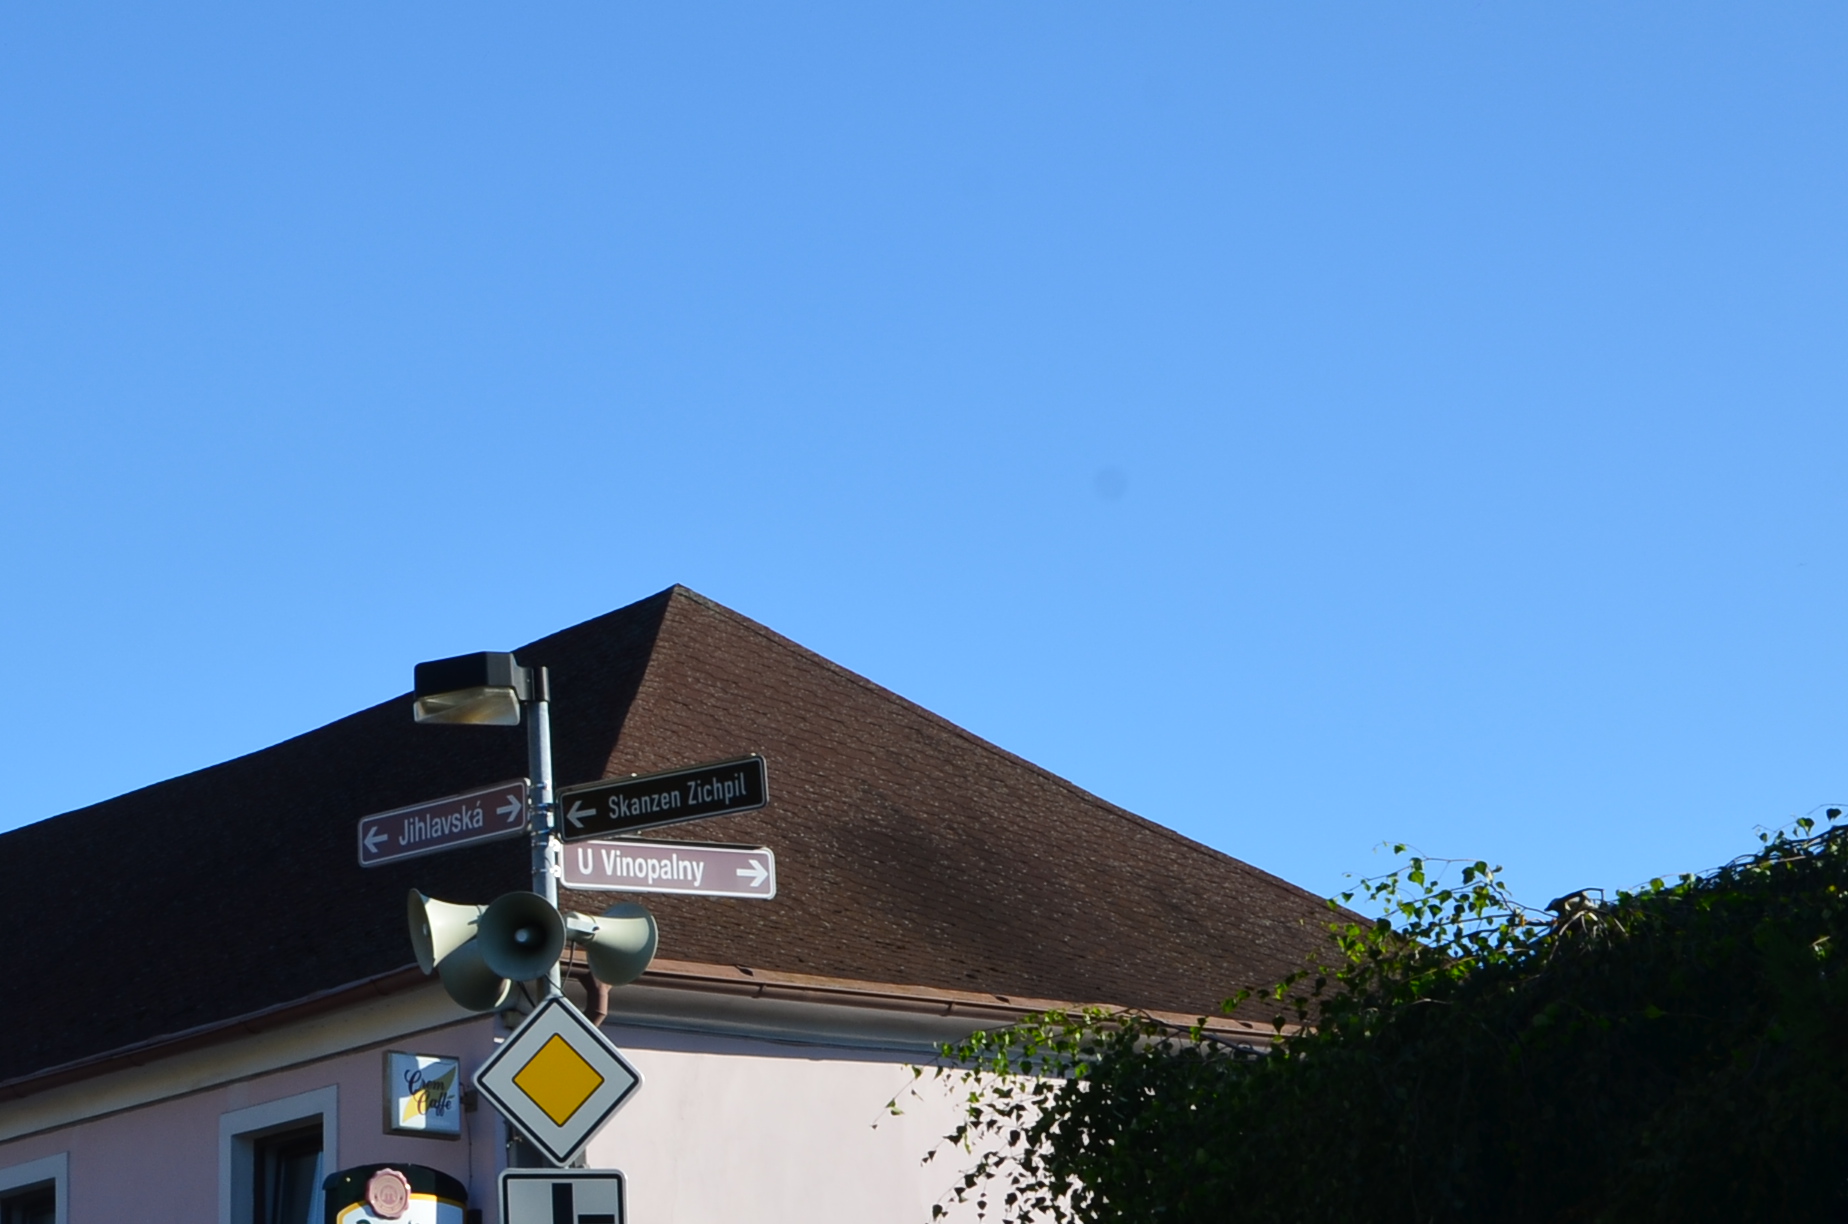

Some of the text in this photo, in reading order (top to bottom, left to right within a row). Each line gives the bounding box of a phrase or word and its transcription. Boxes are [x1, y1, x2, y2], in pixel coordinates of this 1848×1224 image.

[608, 773, 747, 820] Skanzen Zichpil
[398, 802, 484, 847] Jihlavská
[577, 847, 705, 887] U Vinopalny
